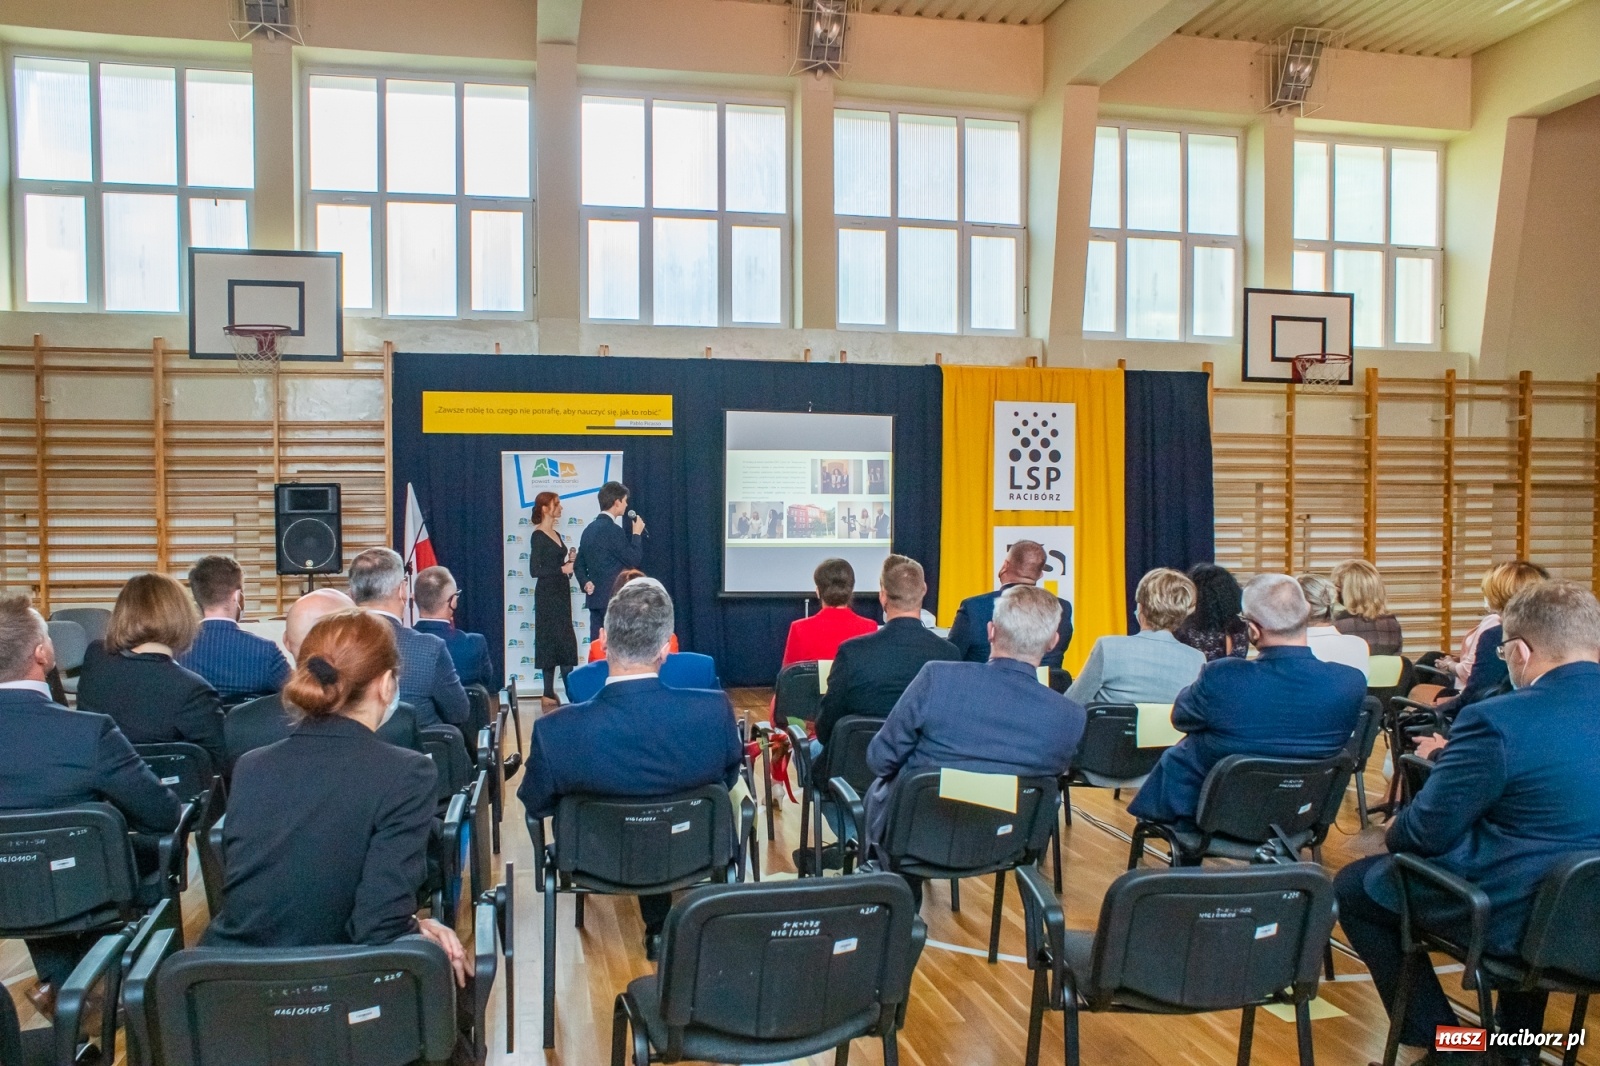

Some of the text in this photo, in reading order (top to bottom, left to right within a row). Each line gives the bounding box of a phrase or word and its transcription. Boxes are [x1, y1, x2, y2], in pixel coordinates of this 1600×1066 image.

[466, 406, 485, 415] robię
[497, 408, 518, 416] czego
[519, 407, 531, 415] nie
[563, 407, 576, 416] aby
[577, 408, 606, 416] nauczyć
[619, 409, 630, 417] jak
[1009, 465, 1062, 491] LSP
[1009, 492, 1061, 501] RACIBÓRZ
